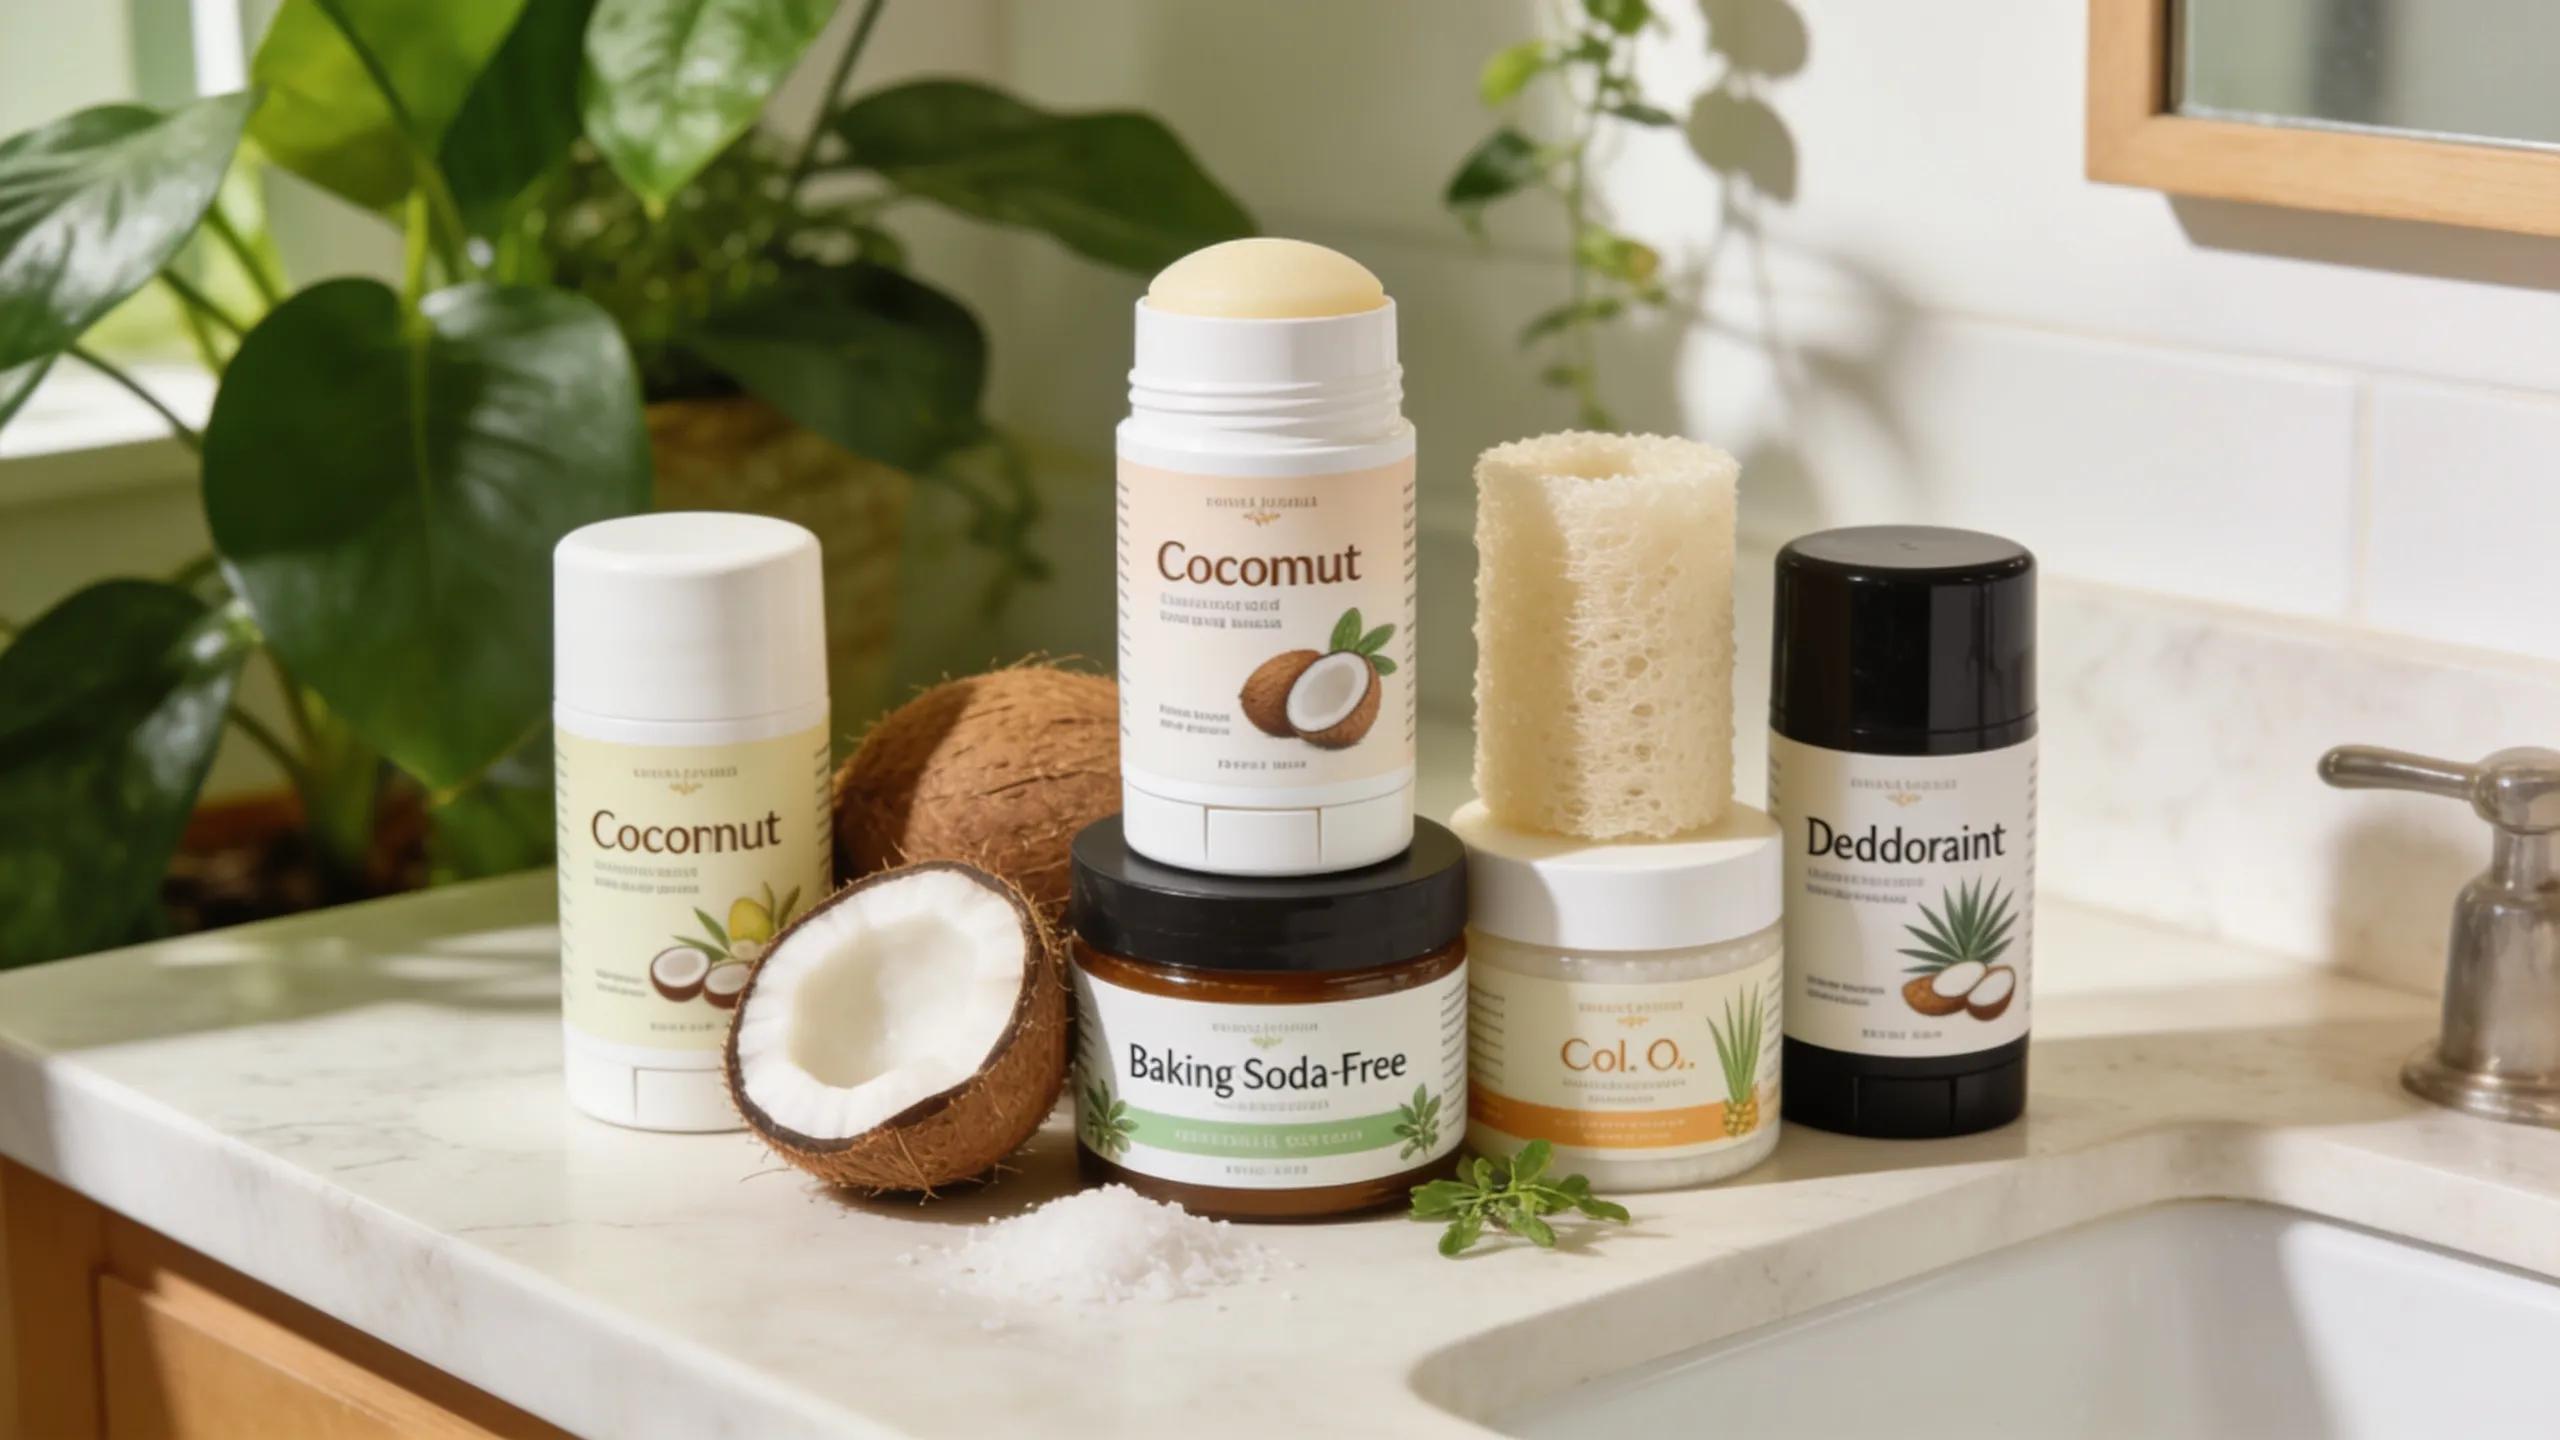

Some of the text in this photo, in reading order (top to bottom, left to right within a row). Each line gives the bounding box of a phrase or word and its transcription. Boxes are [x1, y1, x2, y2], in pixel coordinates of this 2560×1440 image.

[1806, 816, 2006, 864] Deddoraint
[1129, 1043, 1407, 1098] Baking Soda-Free
